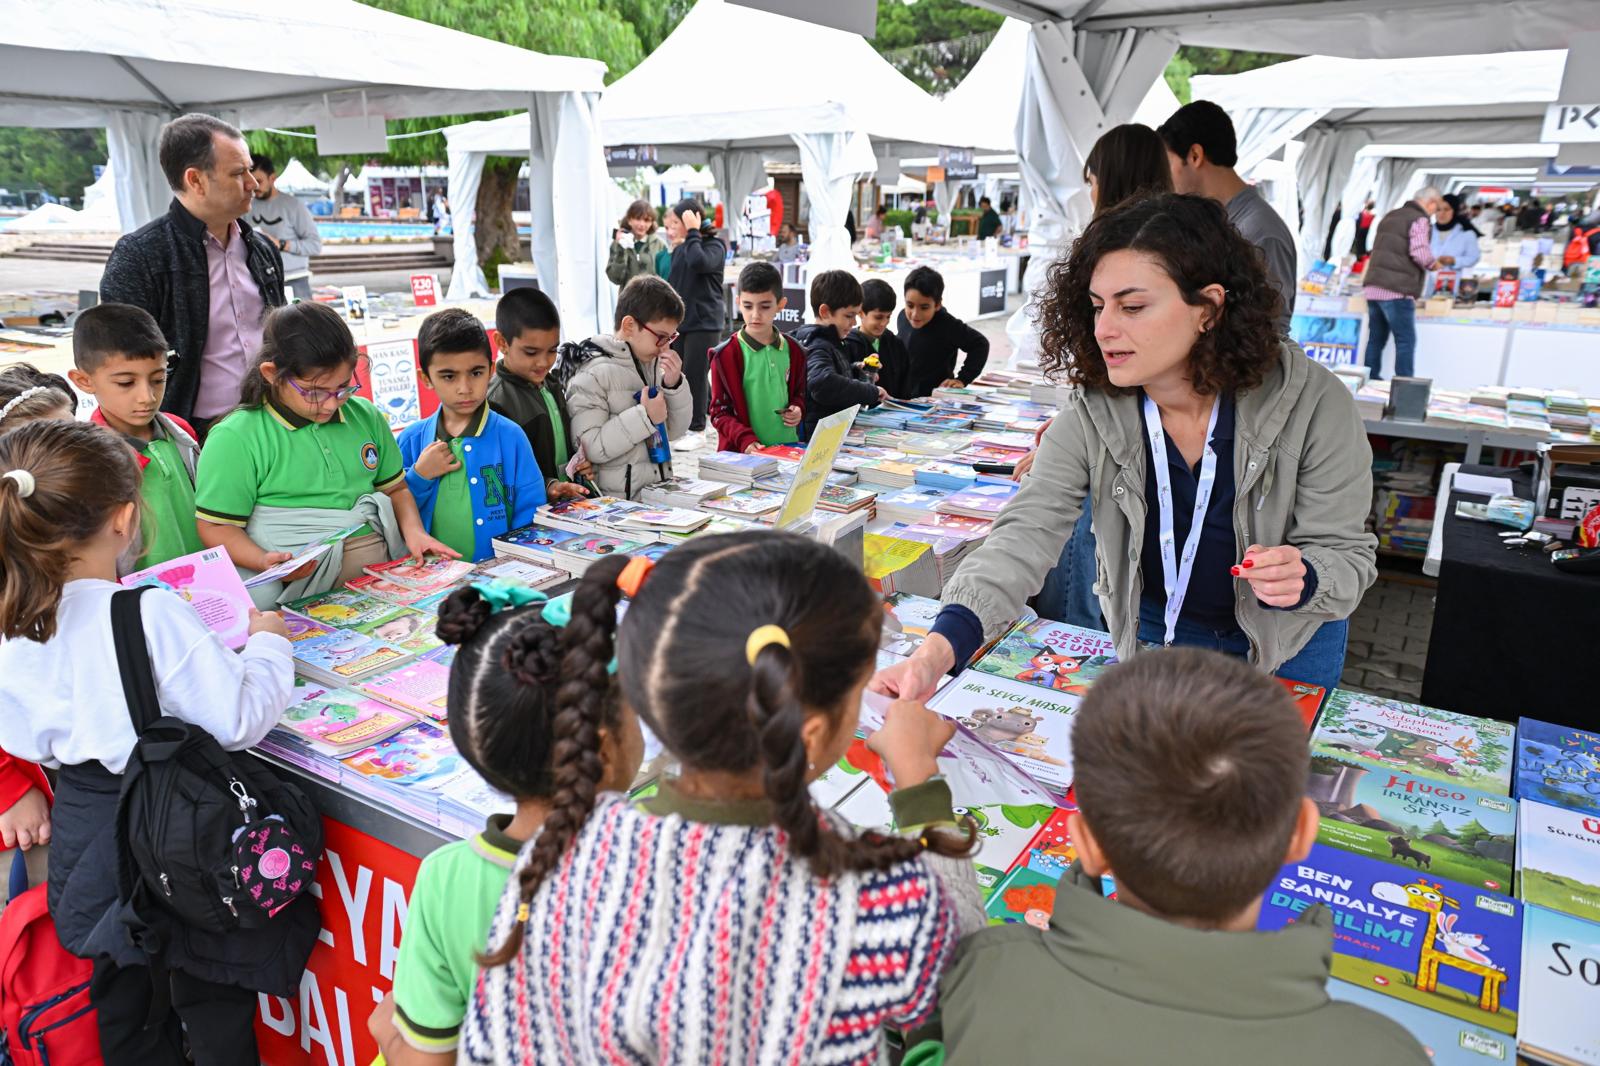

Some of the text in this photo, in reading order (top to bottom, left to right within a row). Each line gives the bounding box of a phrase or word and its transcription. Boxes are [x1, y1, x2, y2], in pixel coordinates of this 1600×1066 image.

[413, 278, 431, 290] 230
[1382, 775, 1466, 800] HUGO
[1297, 865, 1352, 891] BEN
[1279, 877, 1418, 928] SANDALYE
[1270, 891, 1414, 948] DEİLİM!
